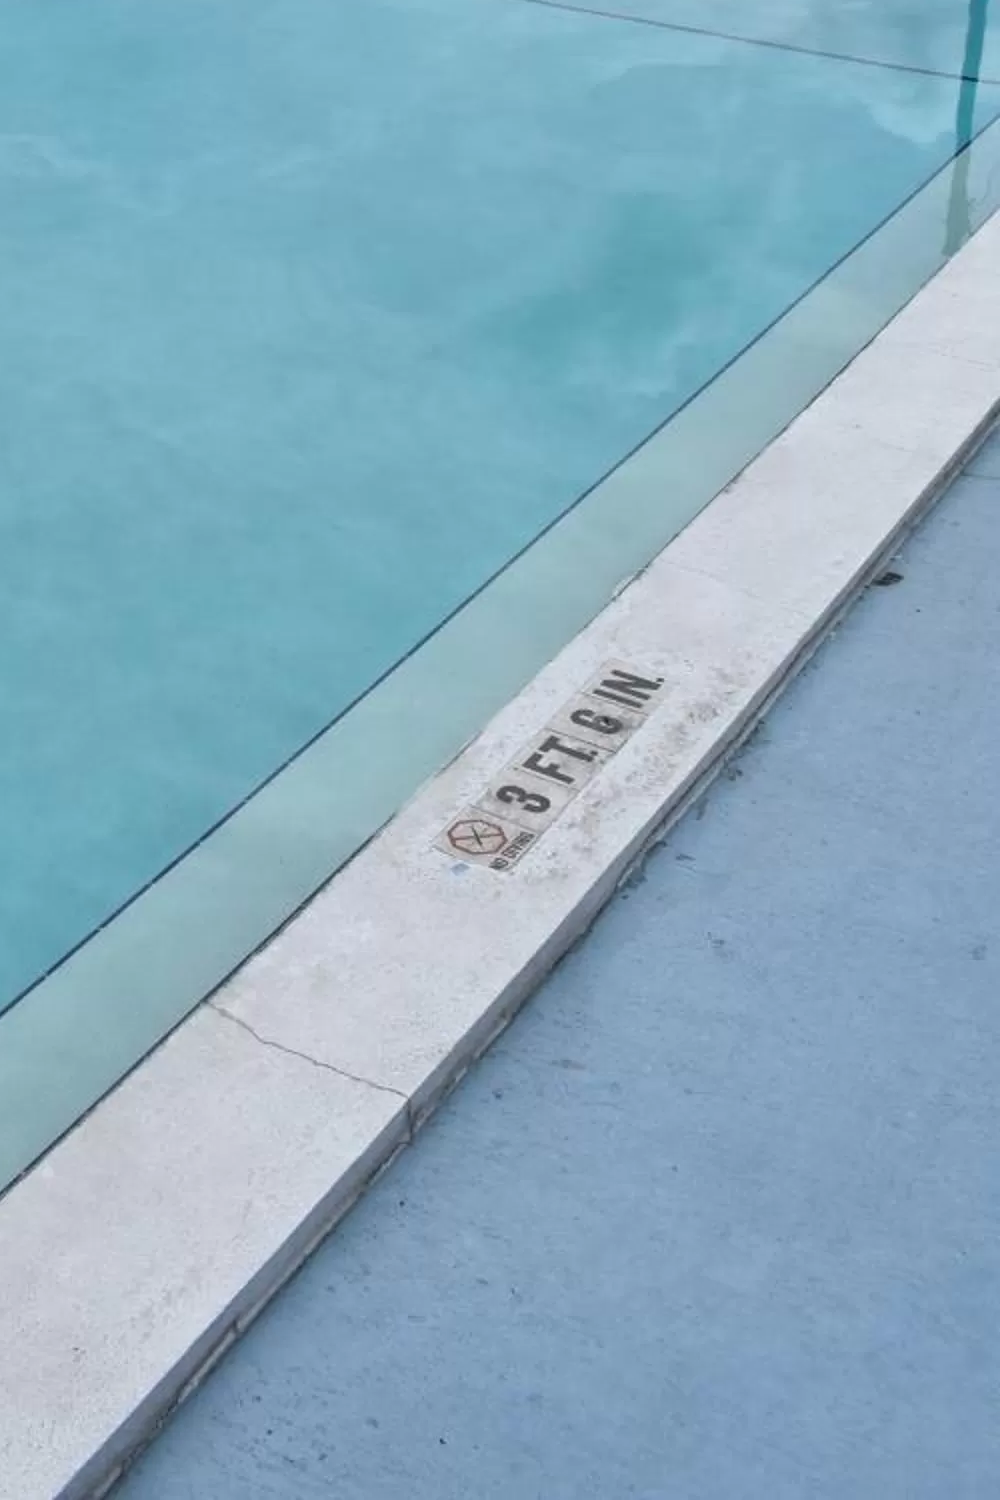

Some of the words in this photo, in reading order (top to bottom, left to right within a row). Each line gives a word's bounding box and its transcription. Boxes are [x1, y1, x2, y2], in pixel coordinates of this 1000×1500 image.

[593, 669, 664, 708] IN.
[570, 709, 623, 734] 6
[522, 735, 598, 785] FT.
[496, 785, 551, 813] 3
